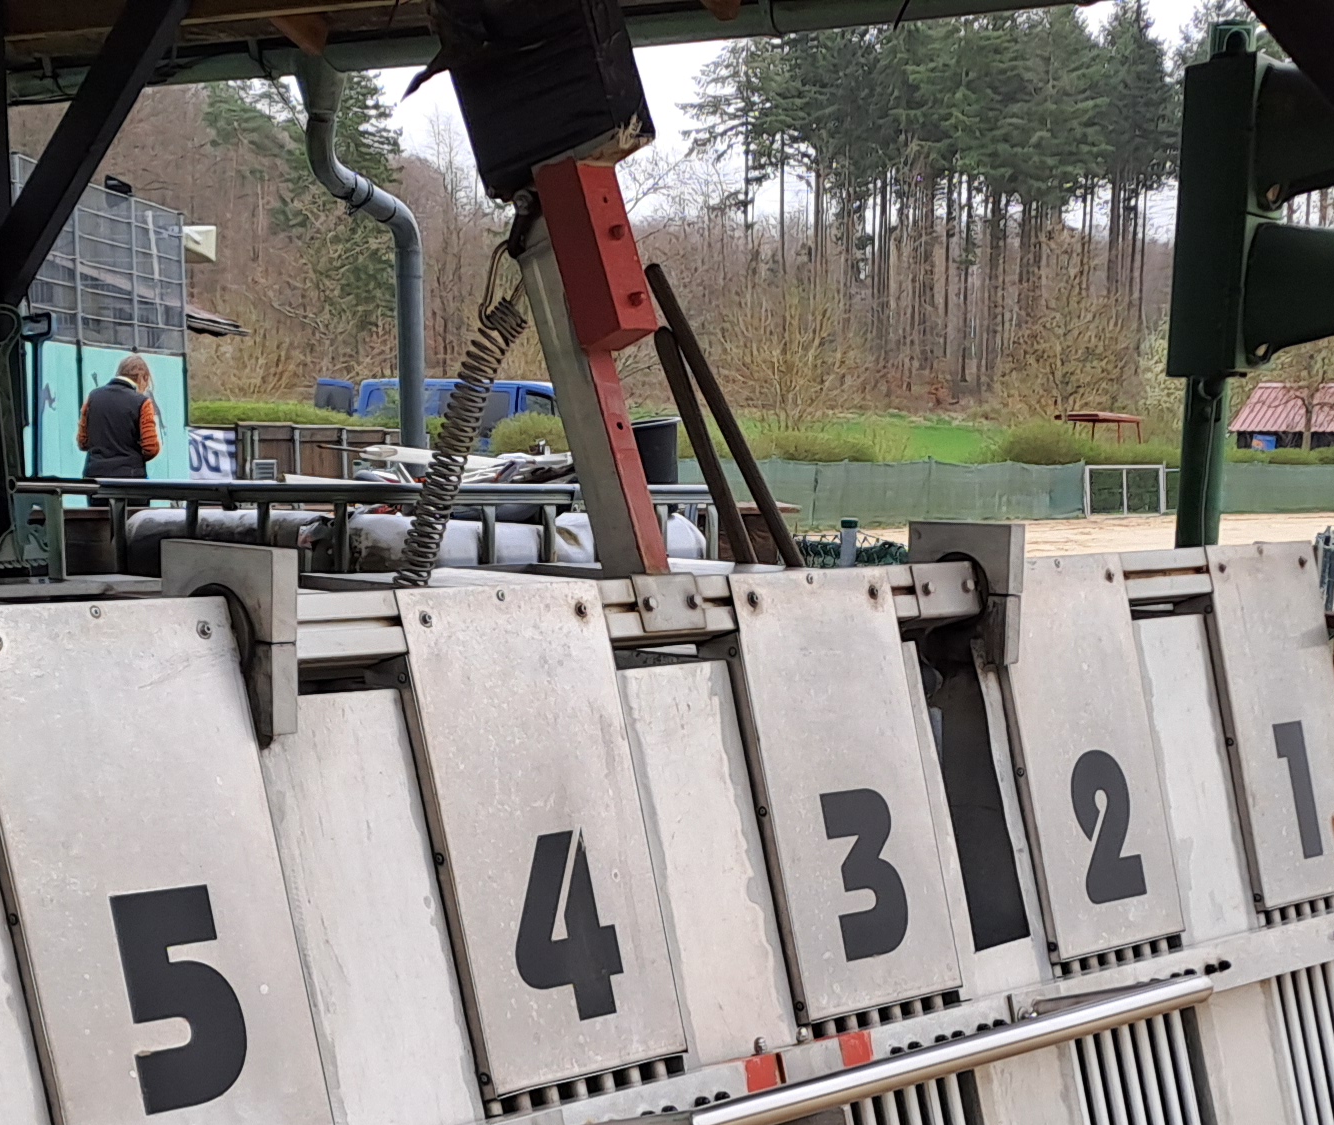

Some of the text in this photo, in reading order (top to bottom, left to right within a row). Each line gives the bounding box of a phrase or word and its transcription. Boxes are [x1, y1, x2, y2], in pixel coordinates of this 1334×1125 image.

[818, 787, 909, 963] 3
[1070, 749, 1148, 905] 2
[1271, 720, 1324, 860] 1
[109, 884, 248, 1116] 5
[514, 828, 624, 1022] 4
